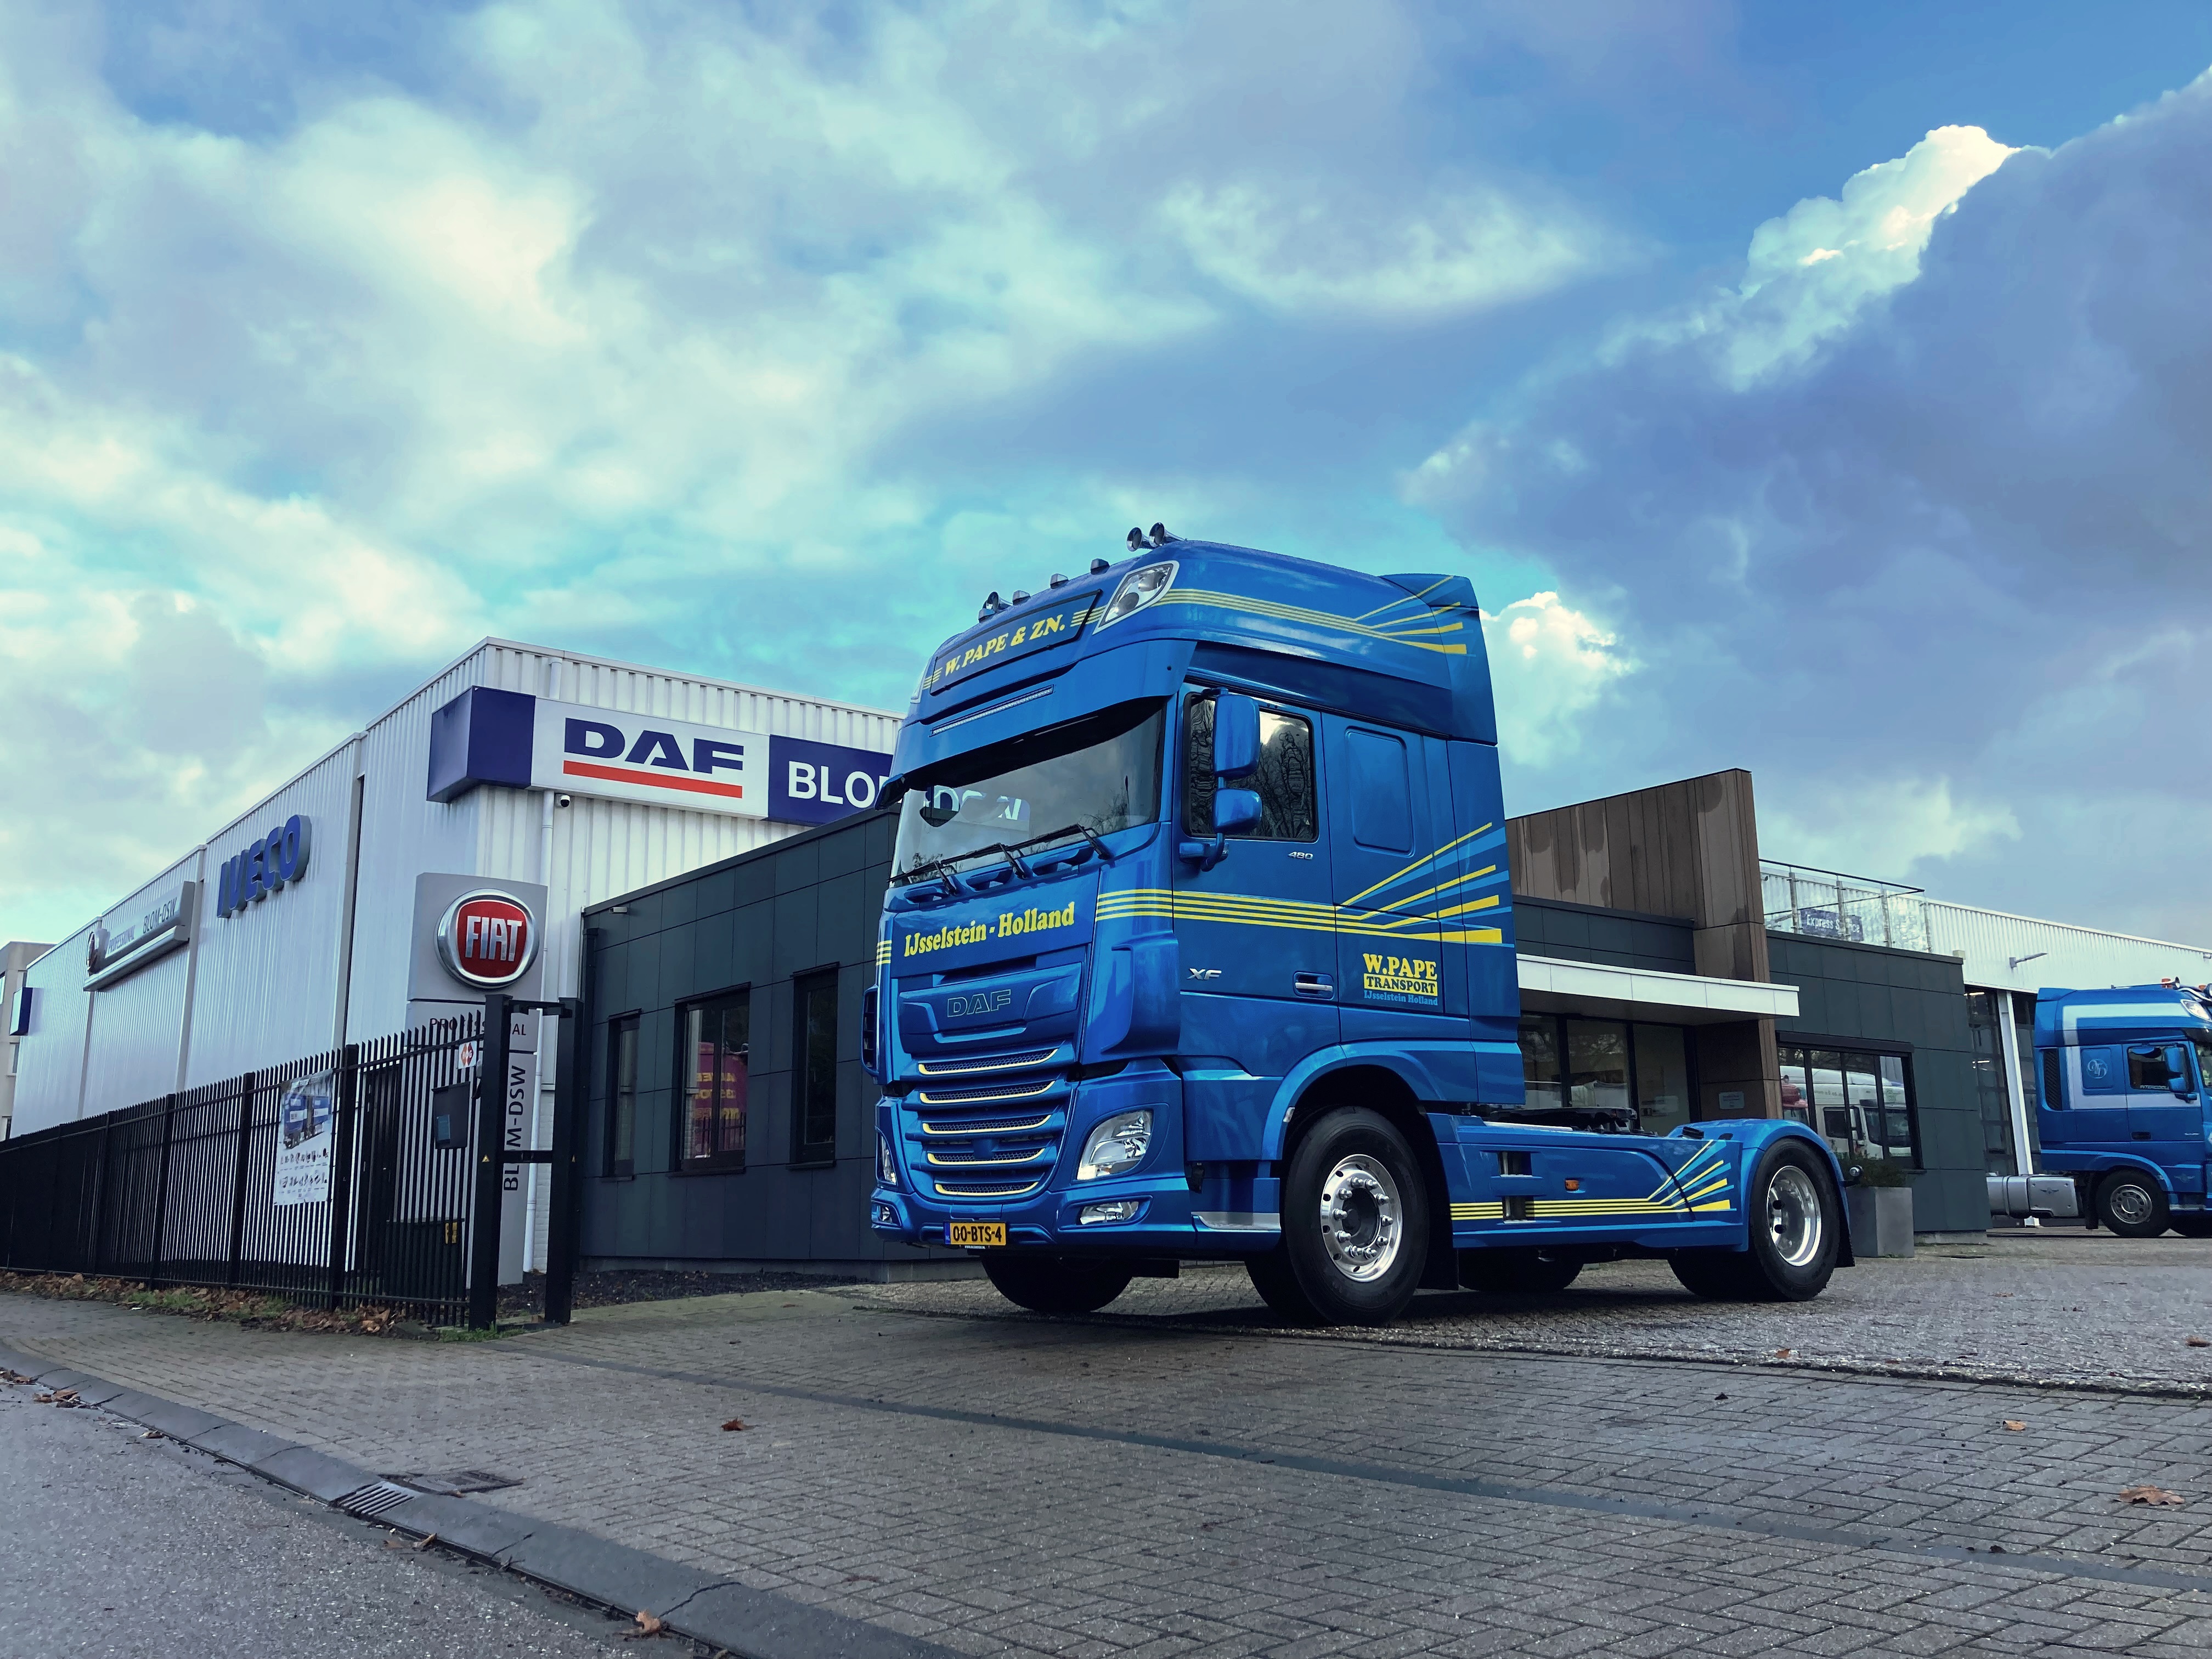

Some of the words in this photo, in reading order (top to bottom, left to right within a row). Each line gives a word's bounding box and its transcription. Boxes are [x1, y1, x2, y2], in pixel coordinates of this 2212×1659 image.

[1010, 626, 1026, 647] &
[1028, 613, 1066, 641] ZN.
[564, 717, 744, 775] DAF
[217, 814, 312, 919] IVECO
[1288, 851, 1314, 860] 480
[143, 896, 177, 934] BLOM-DSW
[904, 920, 986, 957] IJsselstein
[997, 901, 1075, 938] Holland
[1807, 914, 1834, 929] Express
[465, 915, 523, 962] FIAT
[1186, 968, 1222, 980] XF
[1366, 976, 1436, 994] TRANSPORT
[947, 989, 1012, 1018] DAF
[1363, 990, 1407, 1003] IJsselstein
[1407, 994, 1438, 1006] Holland
[503, 1064, 526, 1192] BLM-DSW
[952, 1225, 1002, 1243] 00-BTS-4
